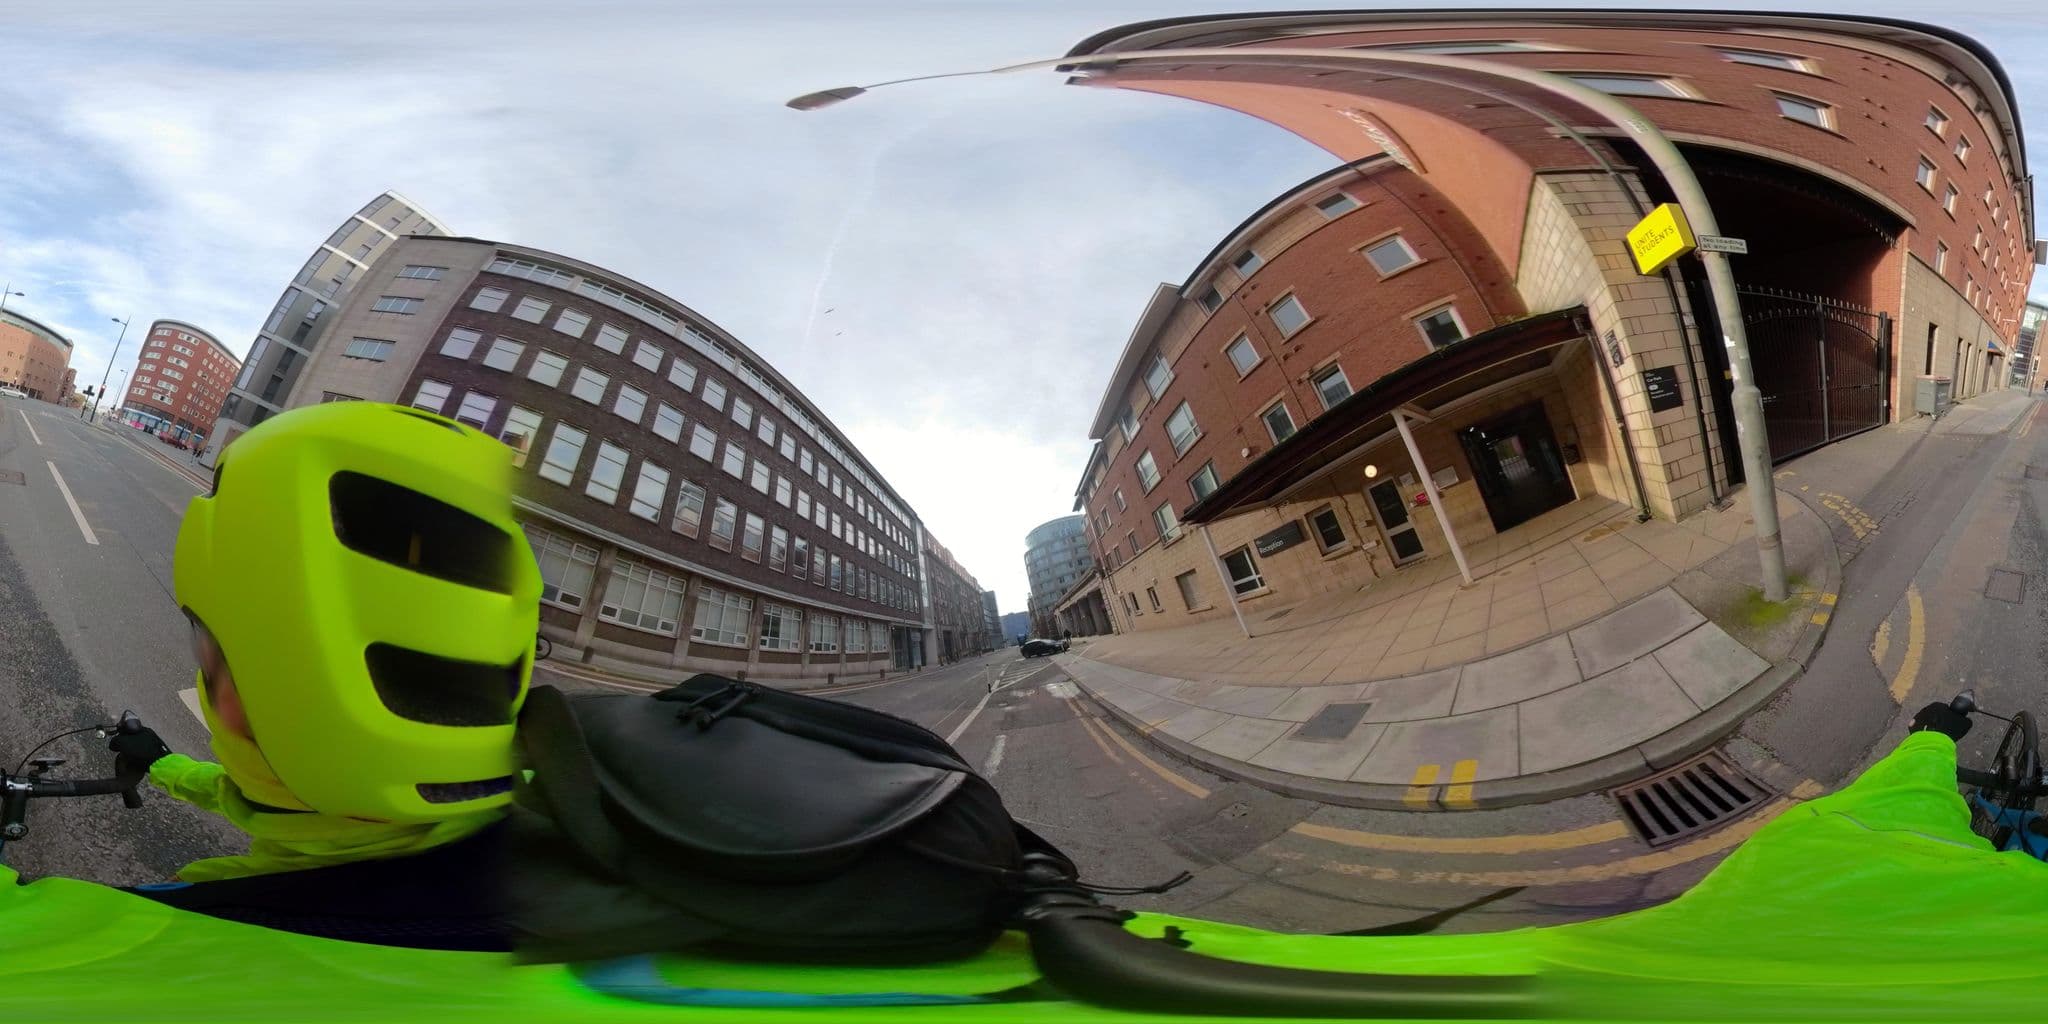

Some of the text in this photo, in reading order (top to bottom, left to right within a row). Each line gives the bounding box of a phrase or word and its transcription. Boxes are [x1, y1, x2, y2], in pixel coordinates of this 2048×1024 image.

[1634, 229, 1656, 249] UNITE
[1638, 225, 1675, 257] STUDENTS
[1258, 540, 1284, 553] Reception
